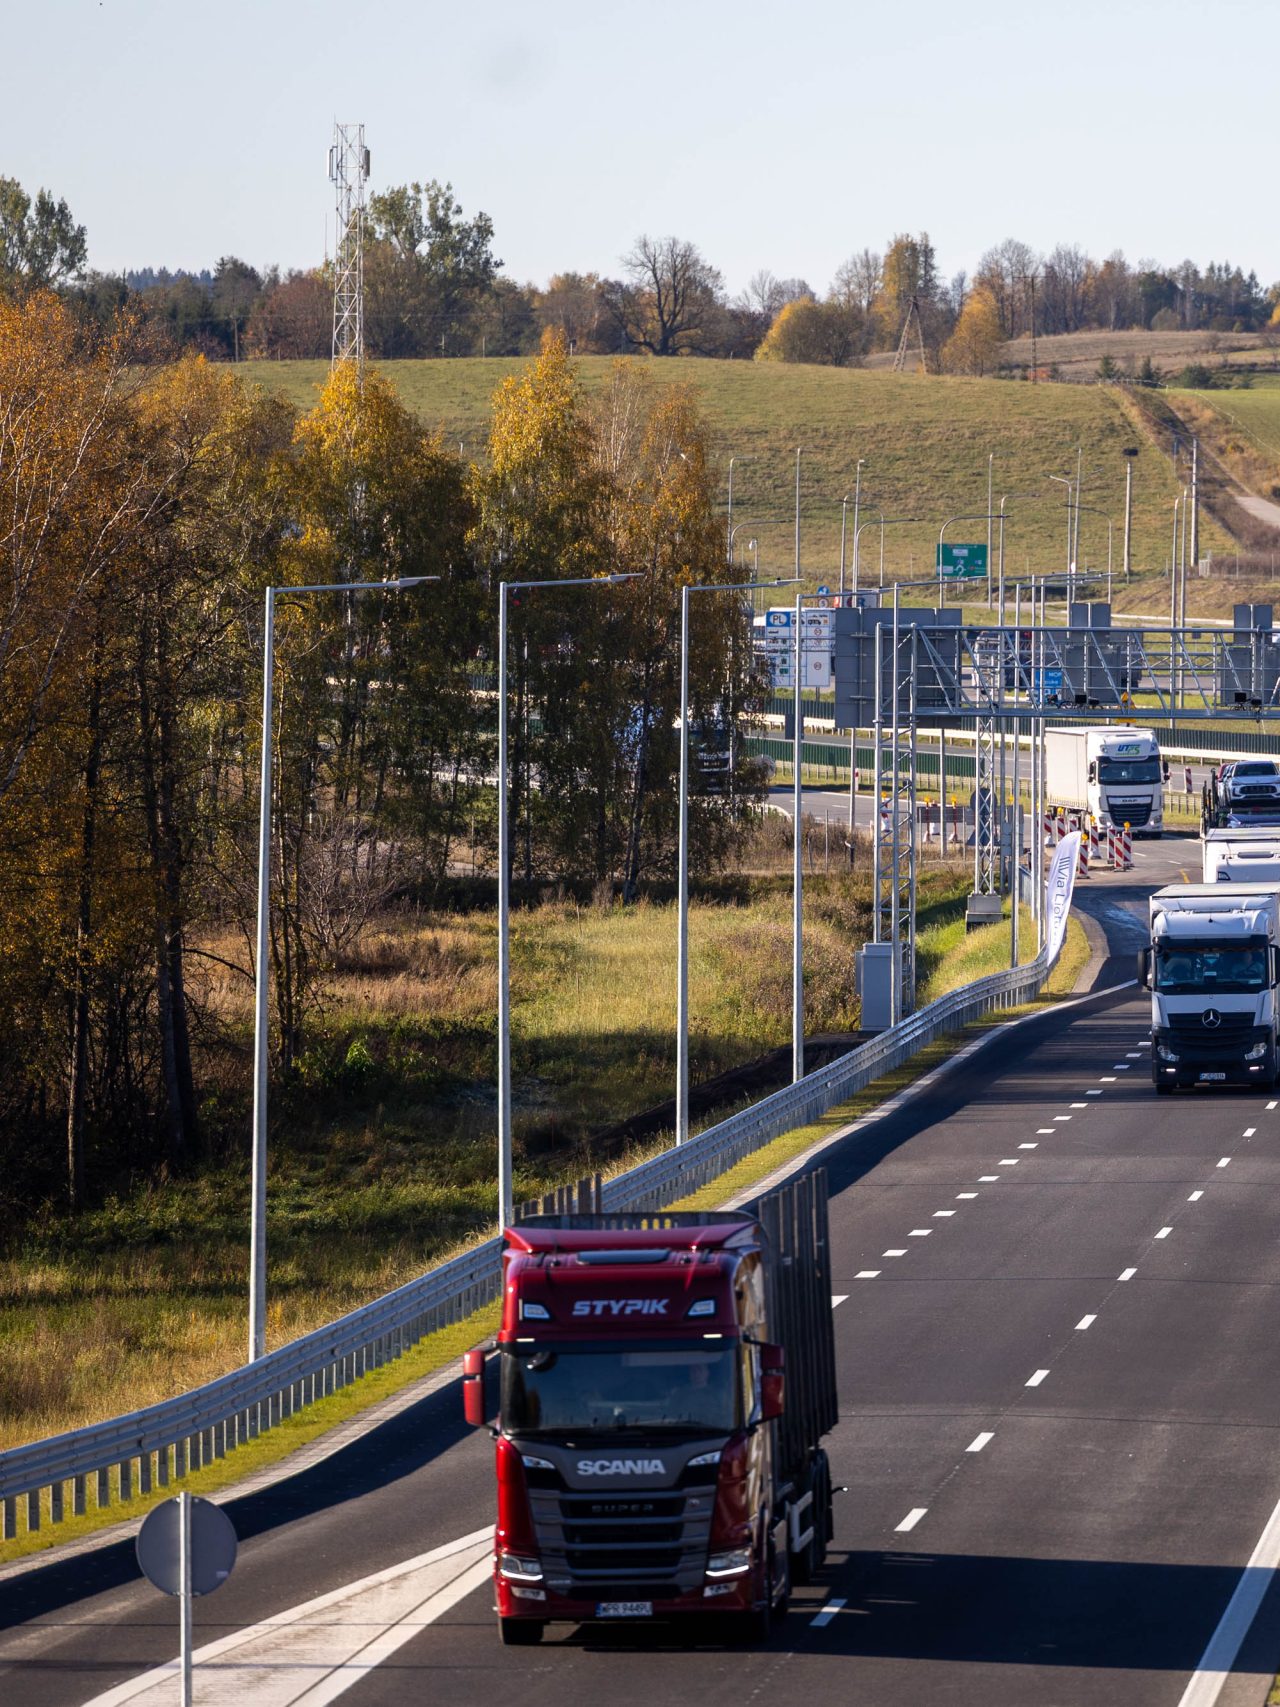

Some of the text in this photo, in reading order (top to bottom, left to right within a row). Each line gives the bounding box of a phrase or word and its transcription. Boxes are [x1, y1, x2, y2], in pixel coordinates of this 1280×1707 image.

[773, 615, 784, 624] PL
[572, 1299, 668, 1316] STYPIK
[577, 1459, 666, 1475] SCANIA
[591, 1503, 655, 1515] SUPER
